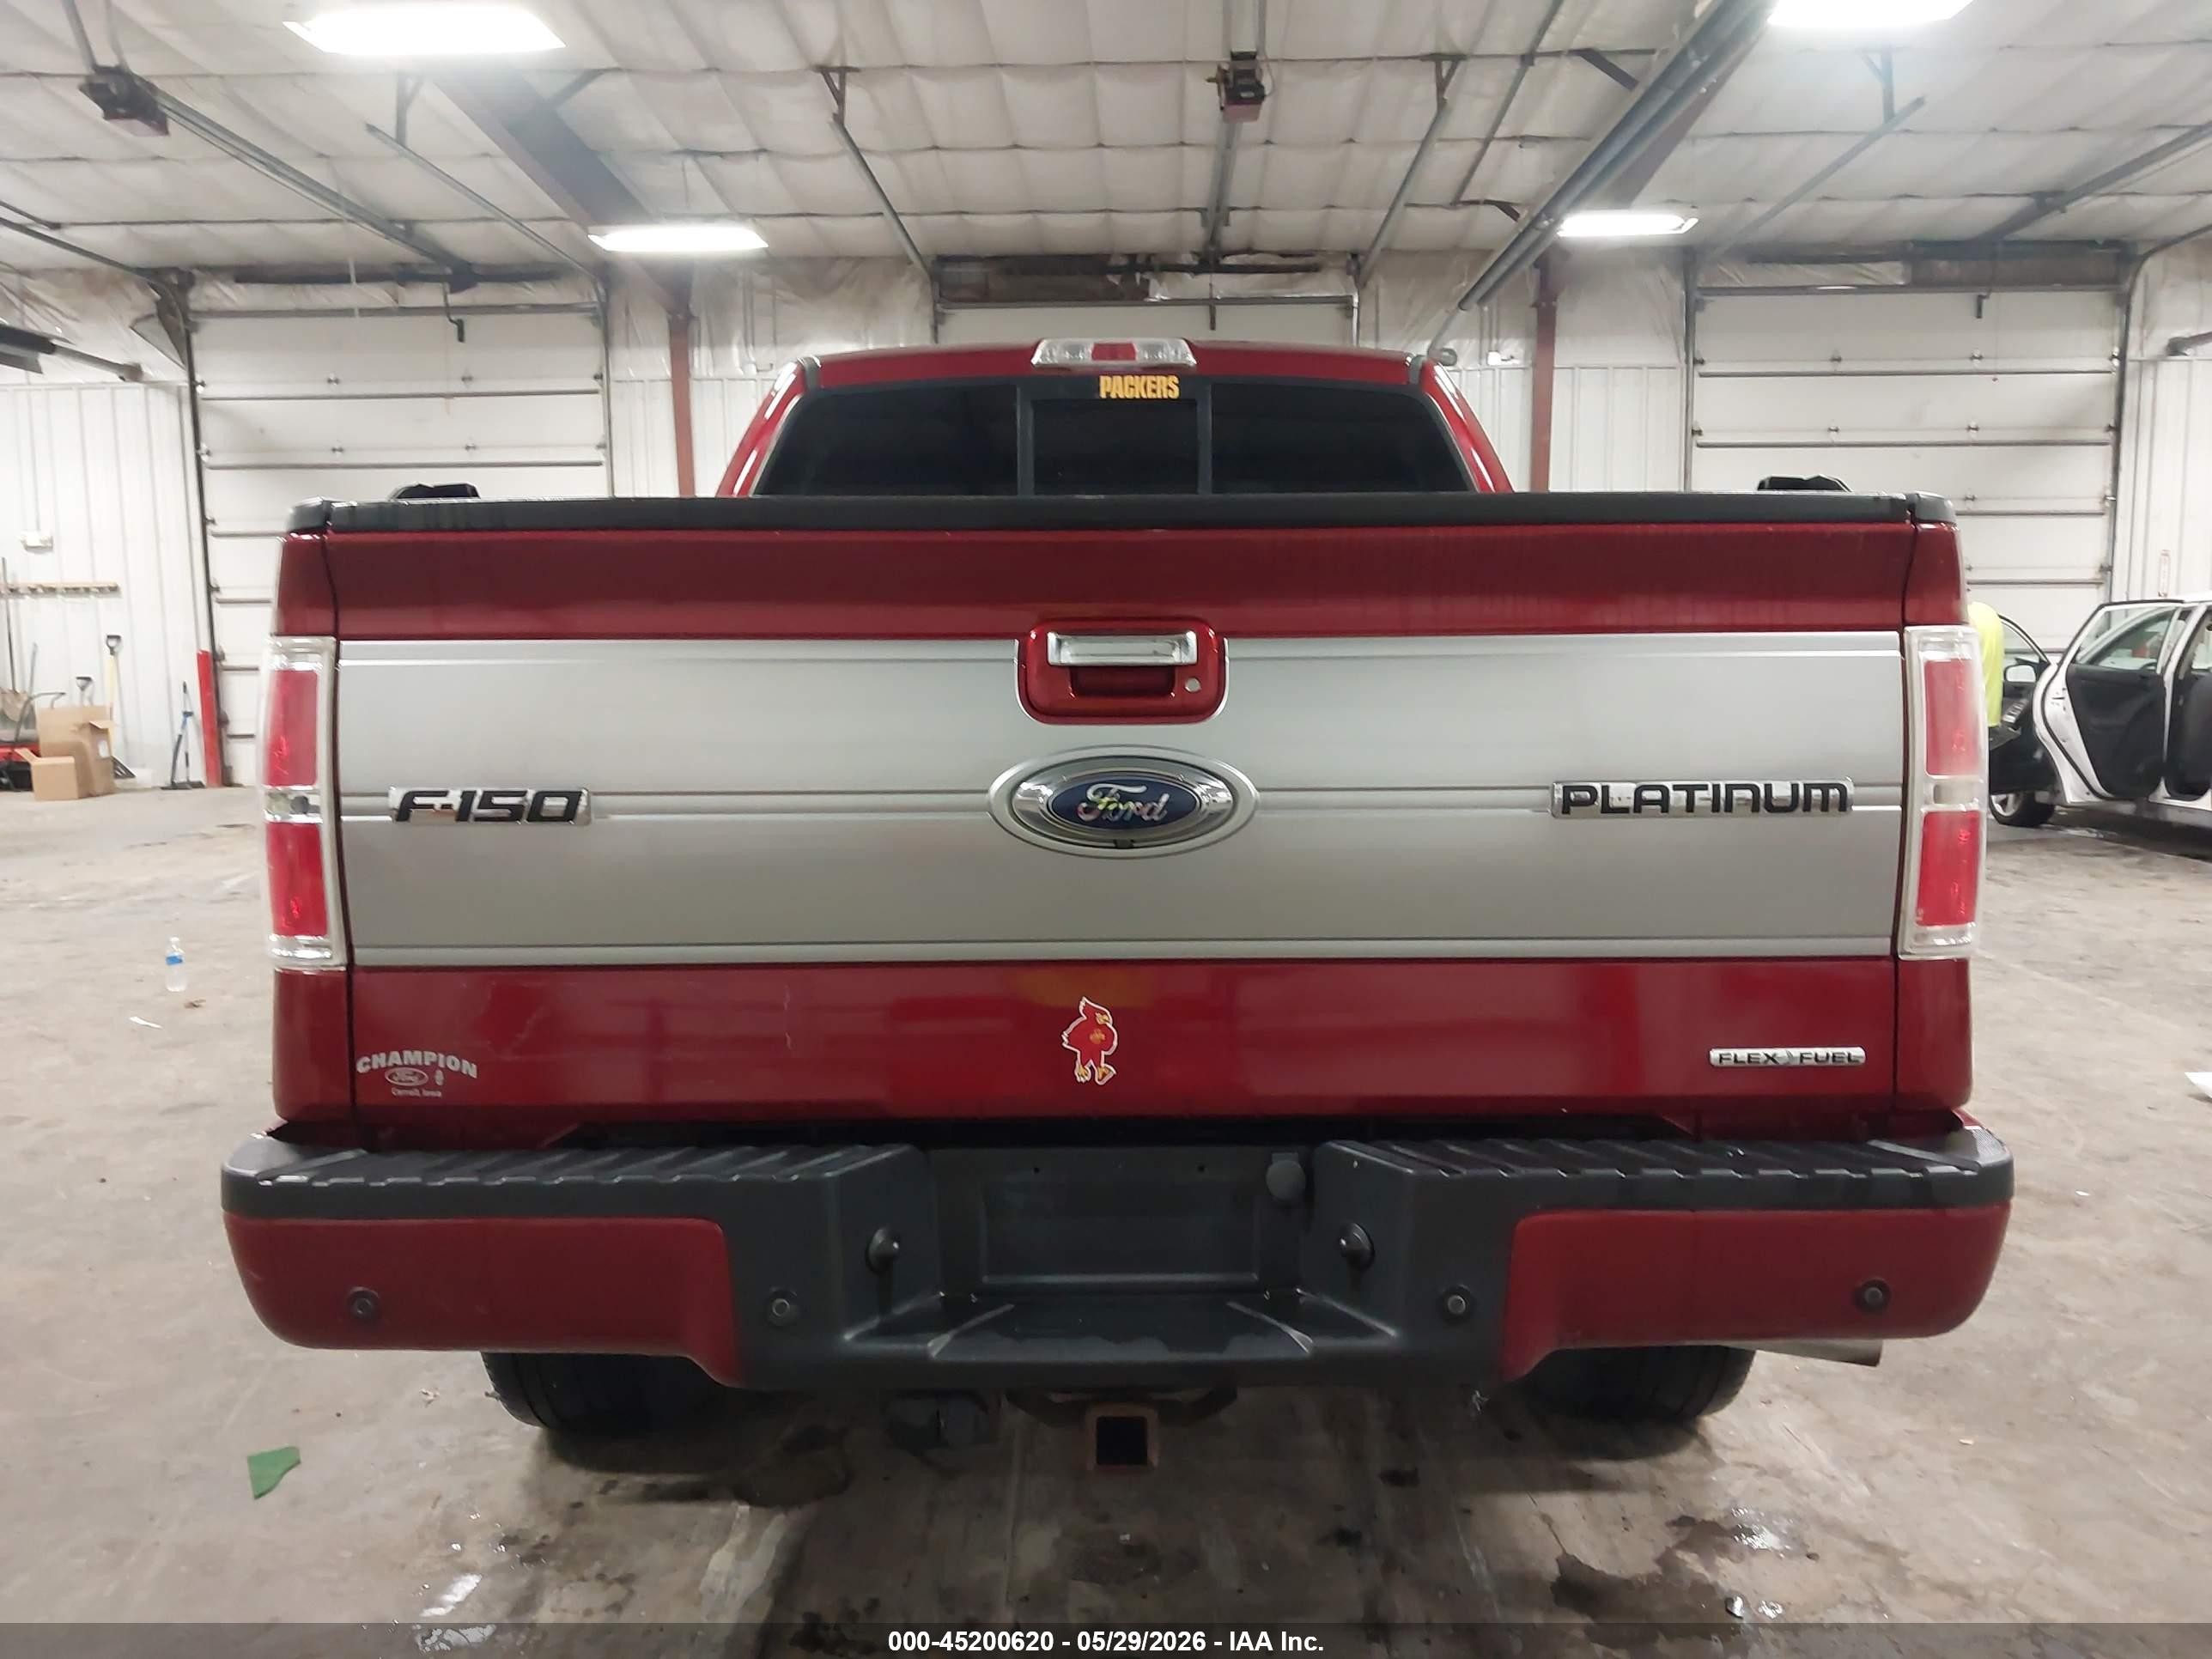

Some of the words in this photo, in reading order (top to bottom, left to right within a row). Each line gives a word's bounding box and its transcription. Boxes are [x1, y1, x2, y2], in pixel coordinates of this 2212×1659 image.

[1099, 374, 1180, 399] PACKERS
[395, 790, 583, 822] F-150
[1077, 782, 1170, 822] Ford
[1561, 783, 1848, 815] PLATINUM
[356, 1049, 477, 1079] CHAMPION
[1718, 1052, 1779, 1065] FLEX
[1799, 1052, 1863, 1064] FUEL
